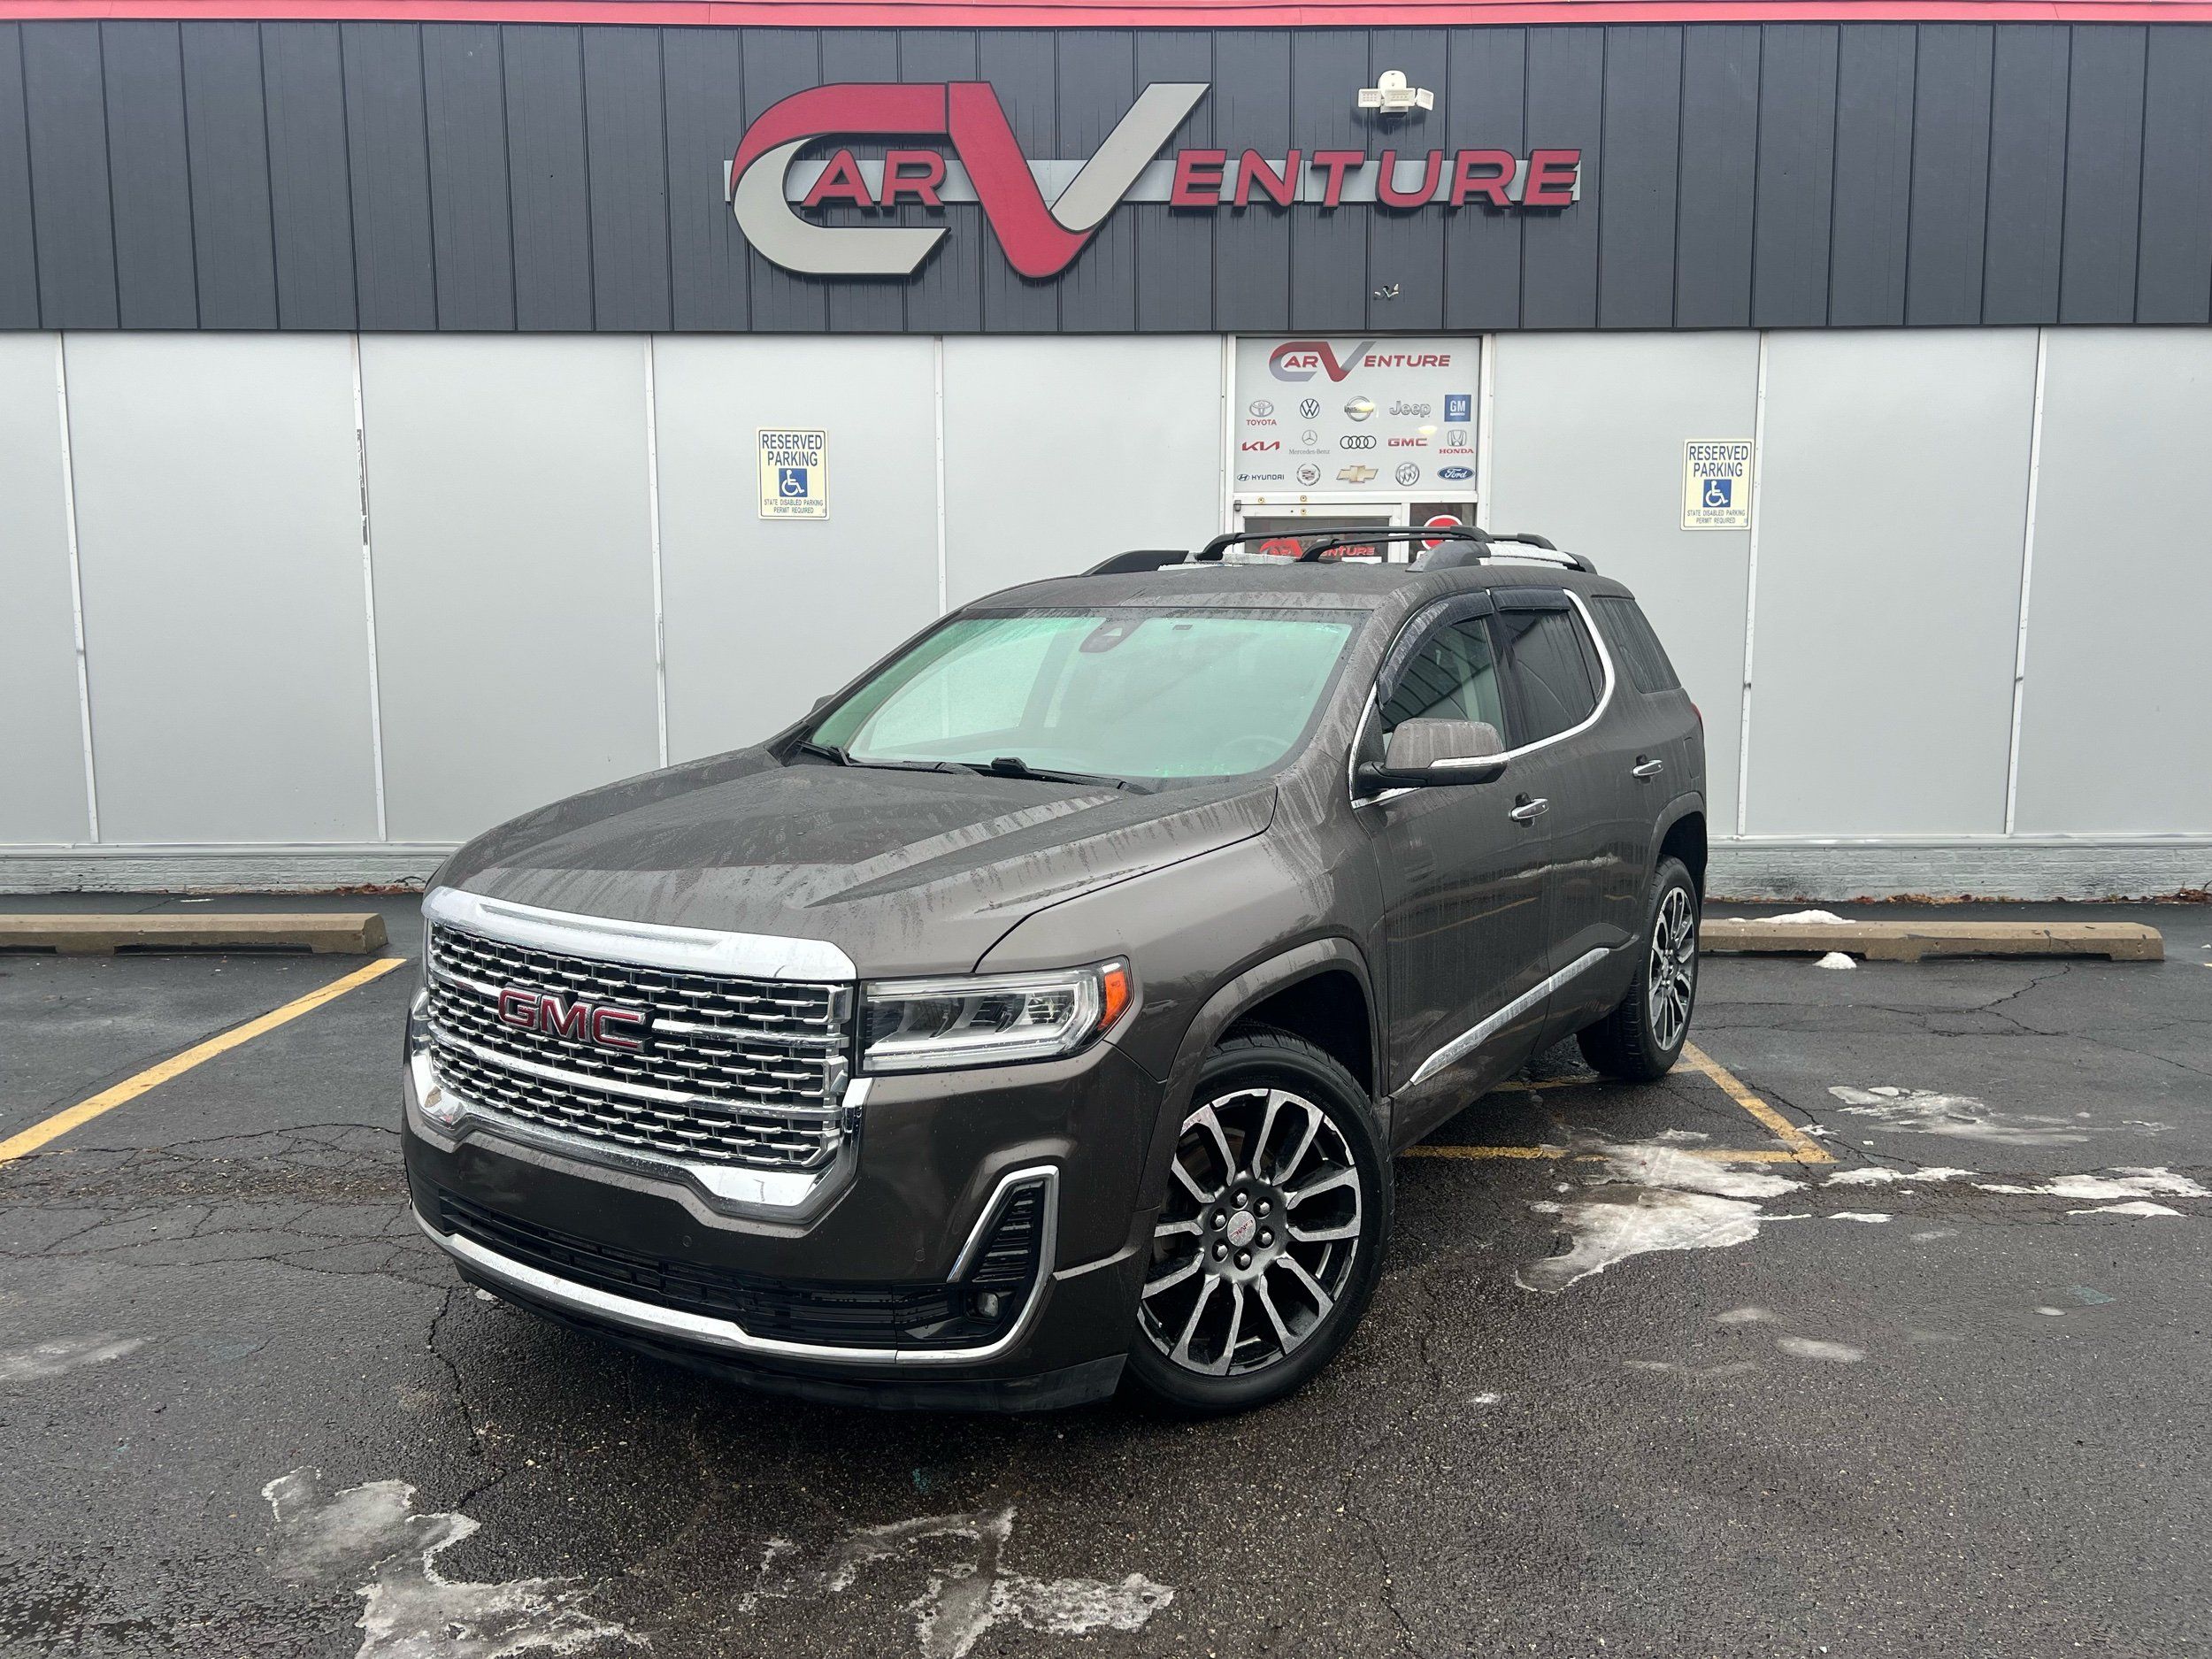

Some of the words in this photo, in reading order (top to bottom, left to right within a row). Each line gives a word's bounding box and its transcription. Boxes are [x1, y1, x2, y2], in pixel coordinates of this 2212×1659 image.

[1389, 400, 1432, 418] Jeep
[1449, 400, 1466, 412] GM
[762, 434, 823, 449] RESERVED
[1387, 437, 1428, 447] GMC
[767, 450, 818, 466] PARKING
[1688, 445, 1748, 461] RESERVED
[1444, 468, 1467, 479] Ford
[1693, 462, 1743, 478] PARKING
[498, 987, 647, 1053] GMC
